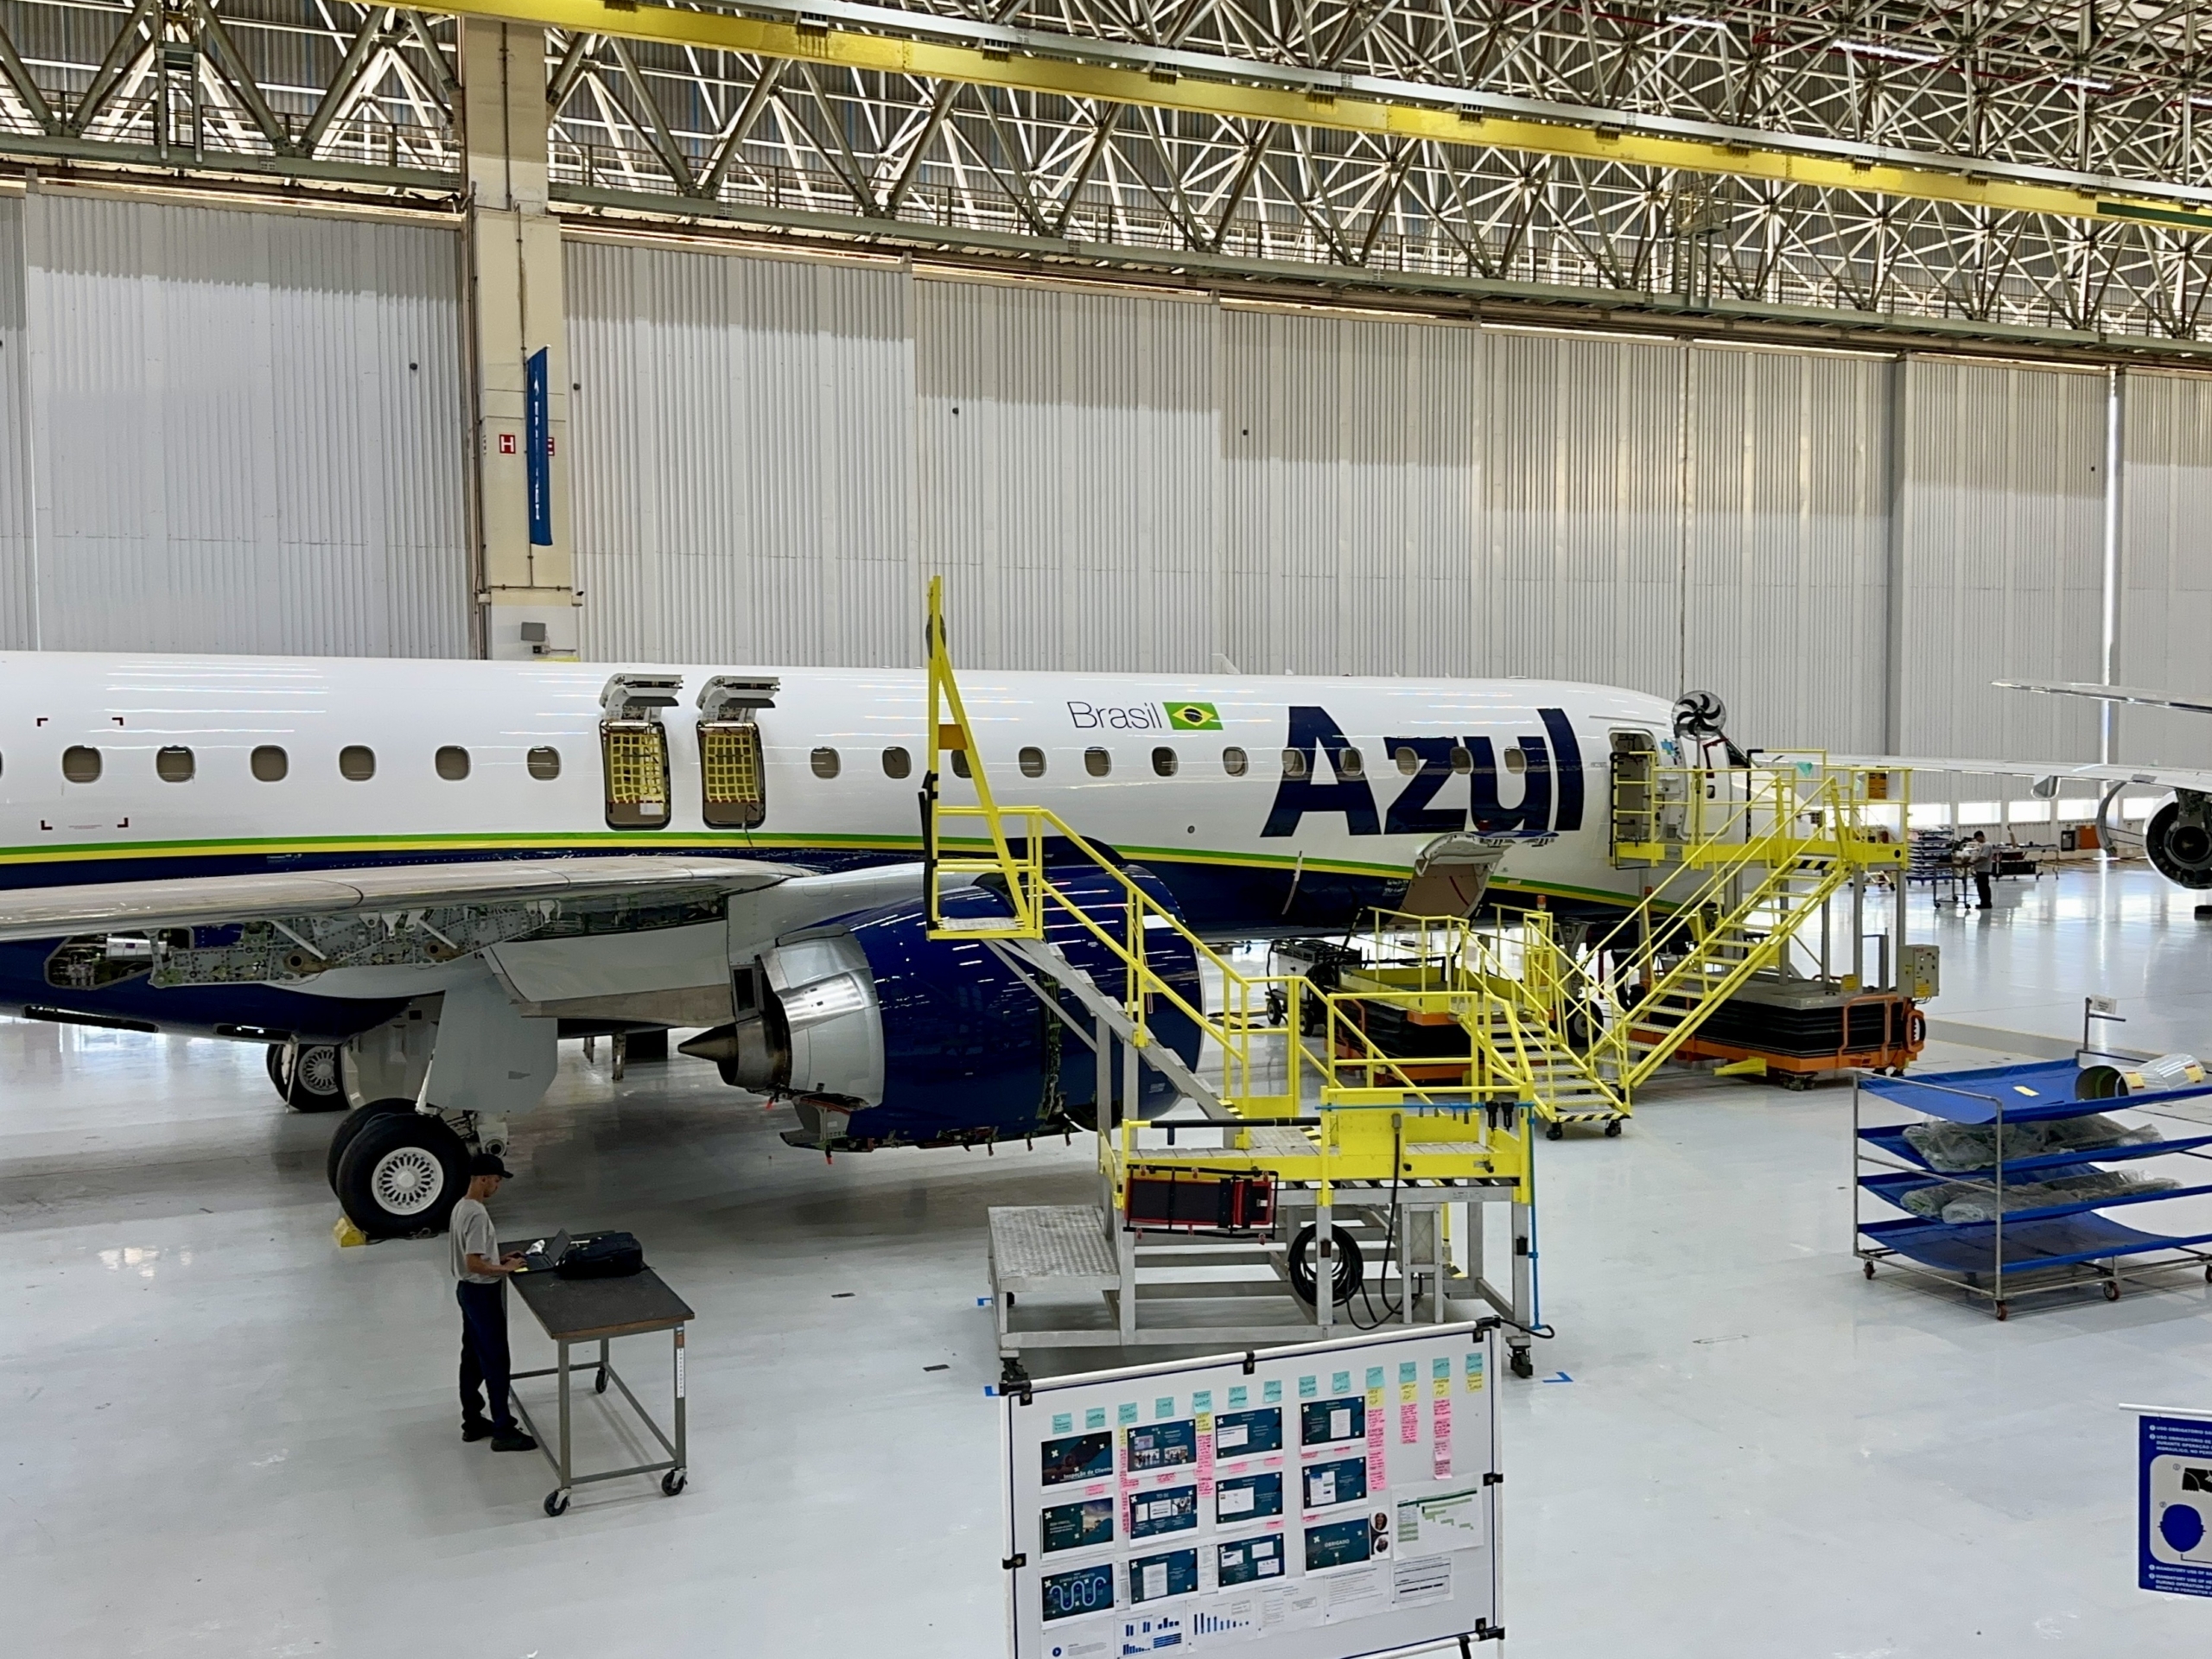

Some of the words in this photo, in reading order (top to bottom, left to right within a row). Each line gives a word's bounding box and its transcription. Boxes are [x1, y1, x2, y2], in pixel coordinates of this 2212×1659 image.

[500, 435, 515, 453] H
[1067, 701, 1162, 730] Brasil
[1260, 705, 1584, 838] Azul
[1324, 1538, 1351, 1548] OBRIGADO
